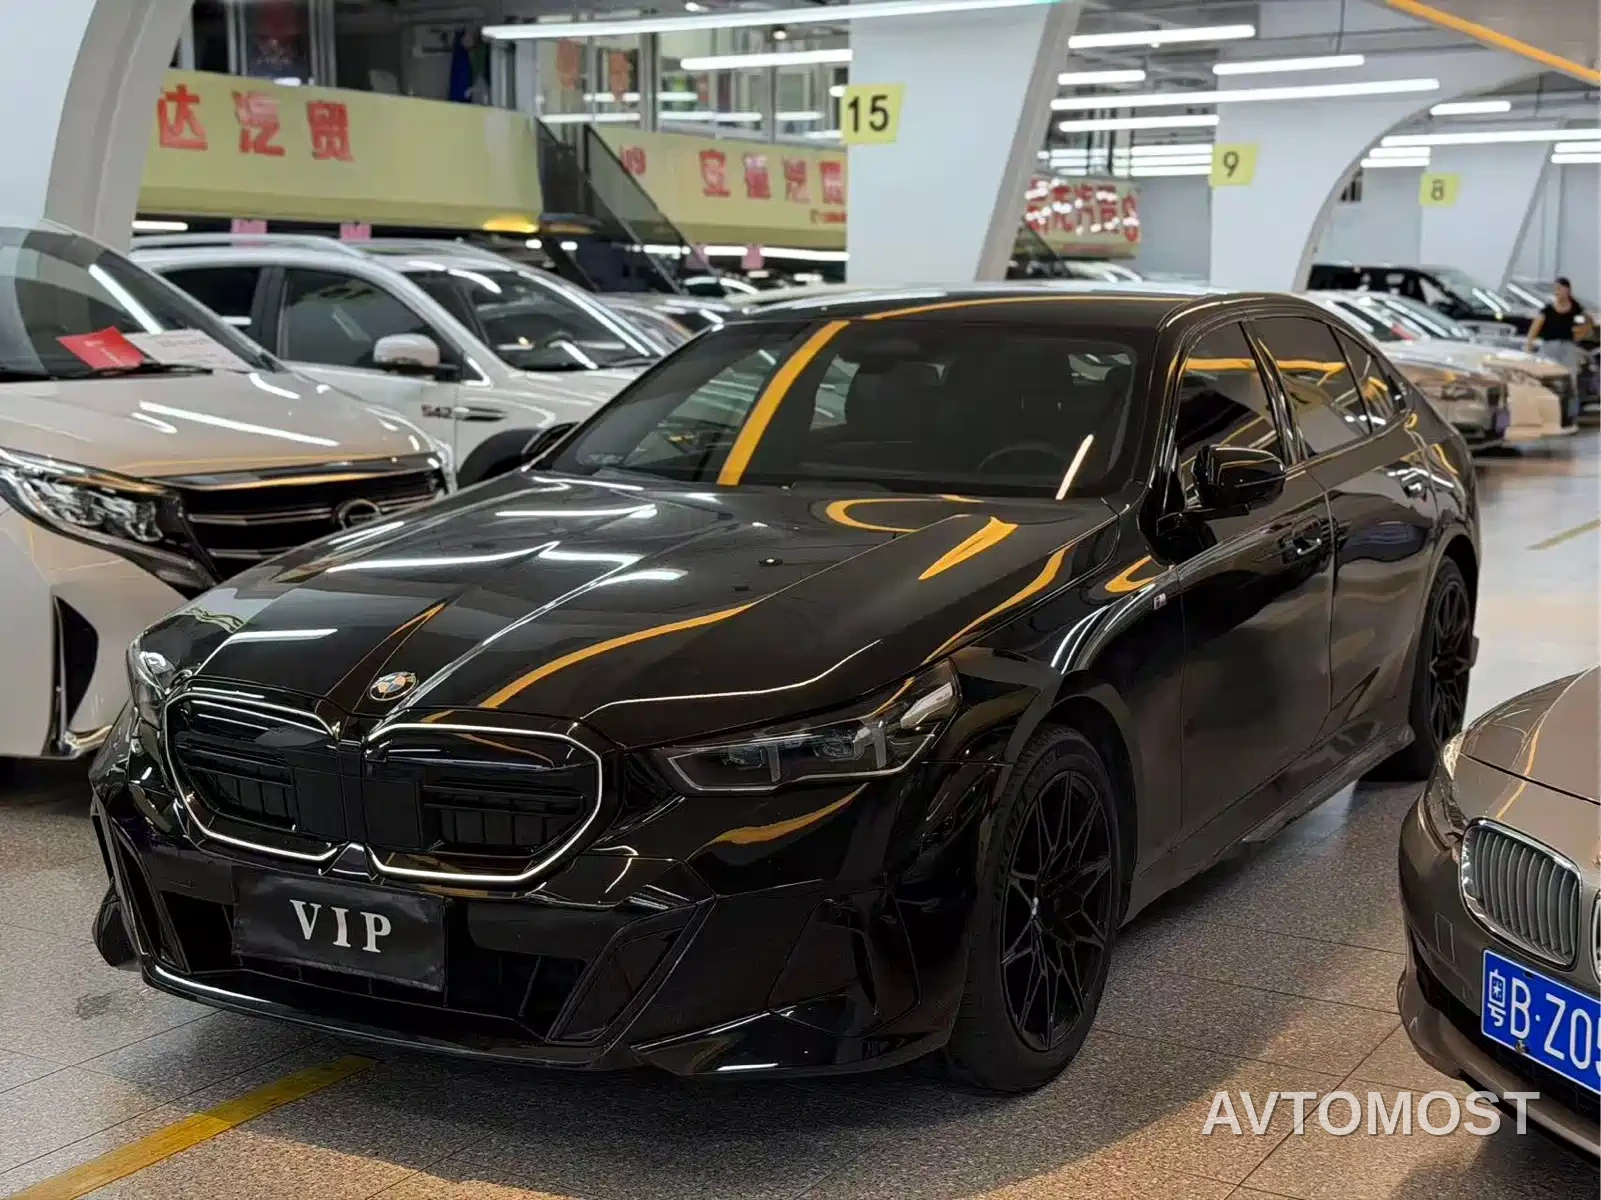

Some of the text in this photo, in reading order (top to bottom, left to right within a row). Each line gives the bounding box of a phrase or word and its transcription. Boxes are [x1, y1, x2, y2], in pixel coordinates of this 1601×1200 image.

[157, 83, 356, 162] 达汽贸
[848, 94, 889, 134] 15
[1223, 150, 1240, 178] 9
[1430, 178, 1445, 201] 8
[289, 899, 392, 953] VIP
[1487, 969, 1600, 1077] 粤B·Z0
